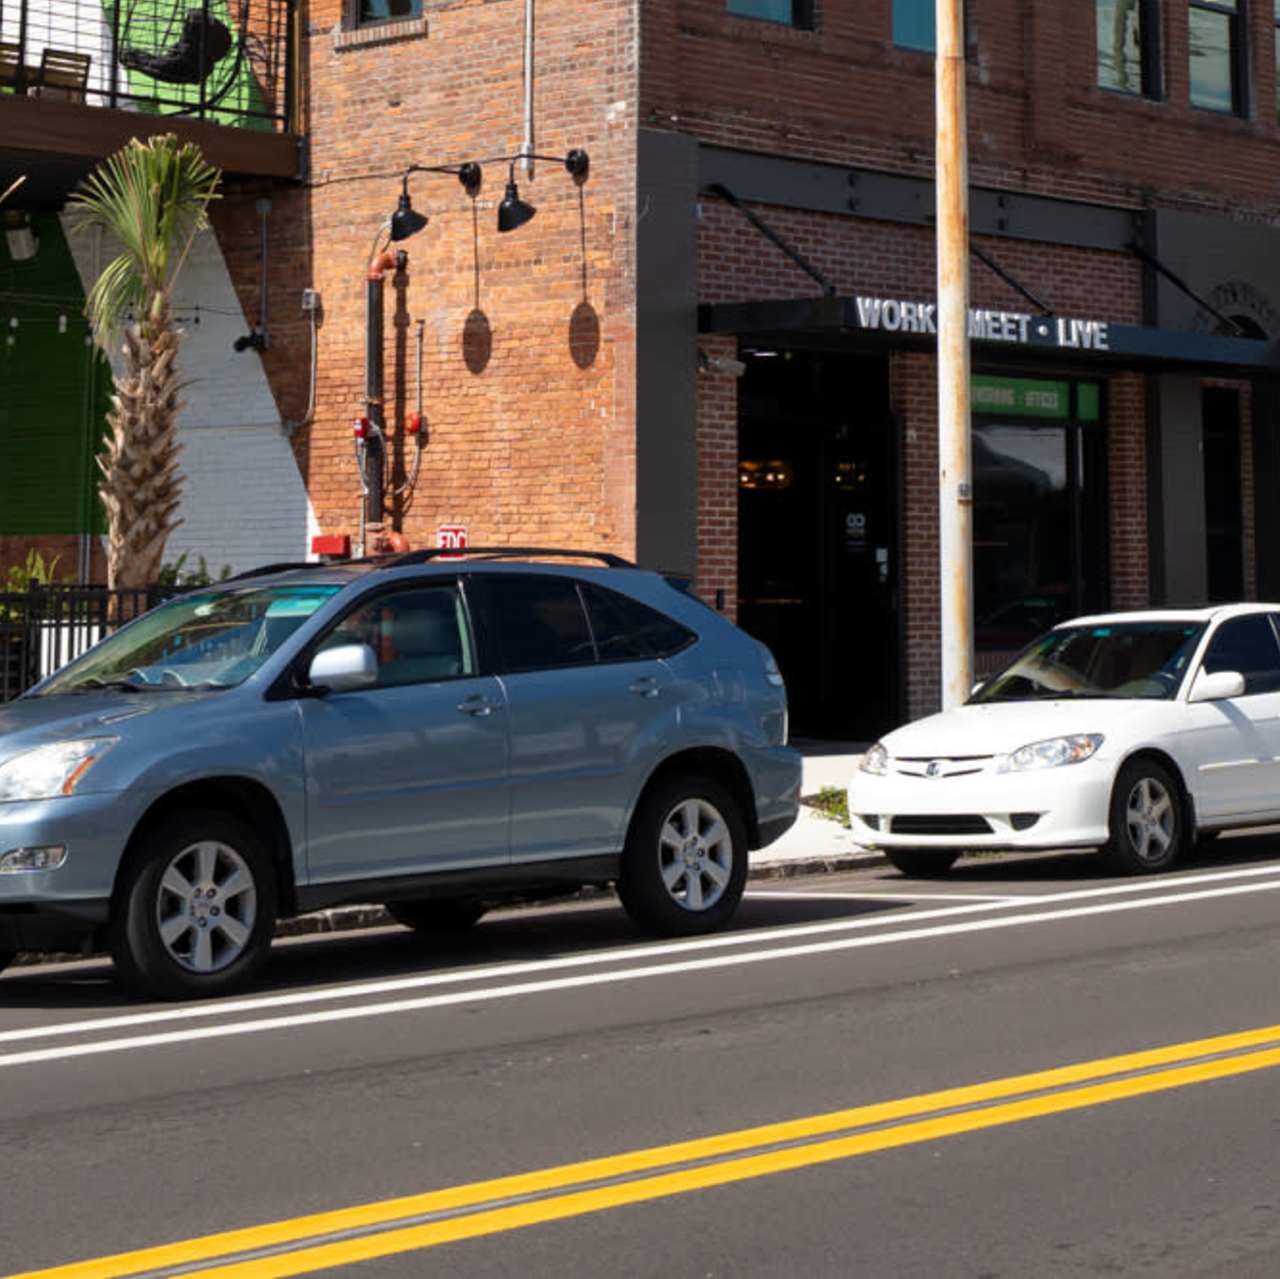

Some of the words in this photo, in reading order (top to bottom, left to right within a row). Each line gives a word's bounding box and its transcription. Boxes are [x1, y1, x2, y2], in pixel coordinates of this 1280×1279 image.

[856, 296, 937, 334] WORK
[968, 308, 1032, 343] MEET
[1057, 318, 1110, 351] LIVE
